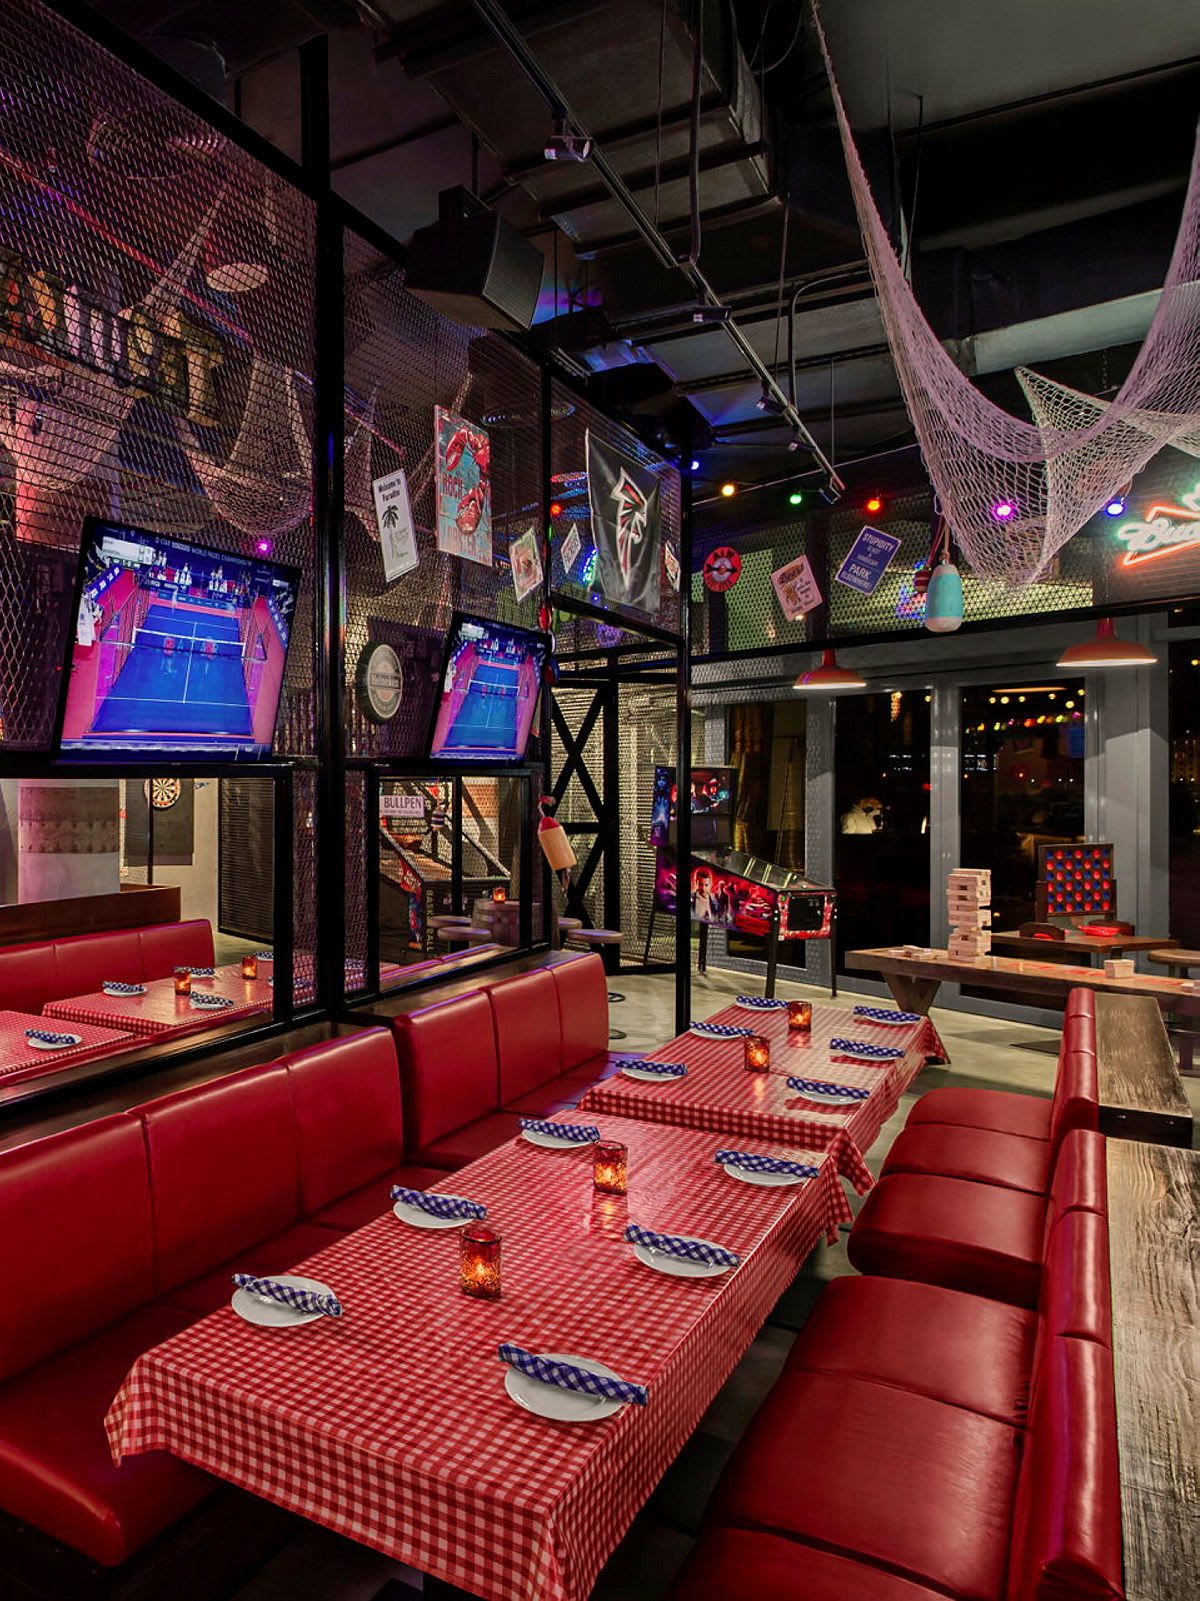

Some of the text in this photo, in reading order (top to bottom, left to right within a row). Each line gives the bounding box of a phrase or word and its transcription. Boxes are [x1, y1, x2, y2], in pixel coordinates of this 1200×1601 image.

[862, 533, 895, 552] STUPIDITY
[848, 563, 872, 580] PARK
[383, 796, 422, 810] BULLPEN
